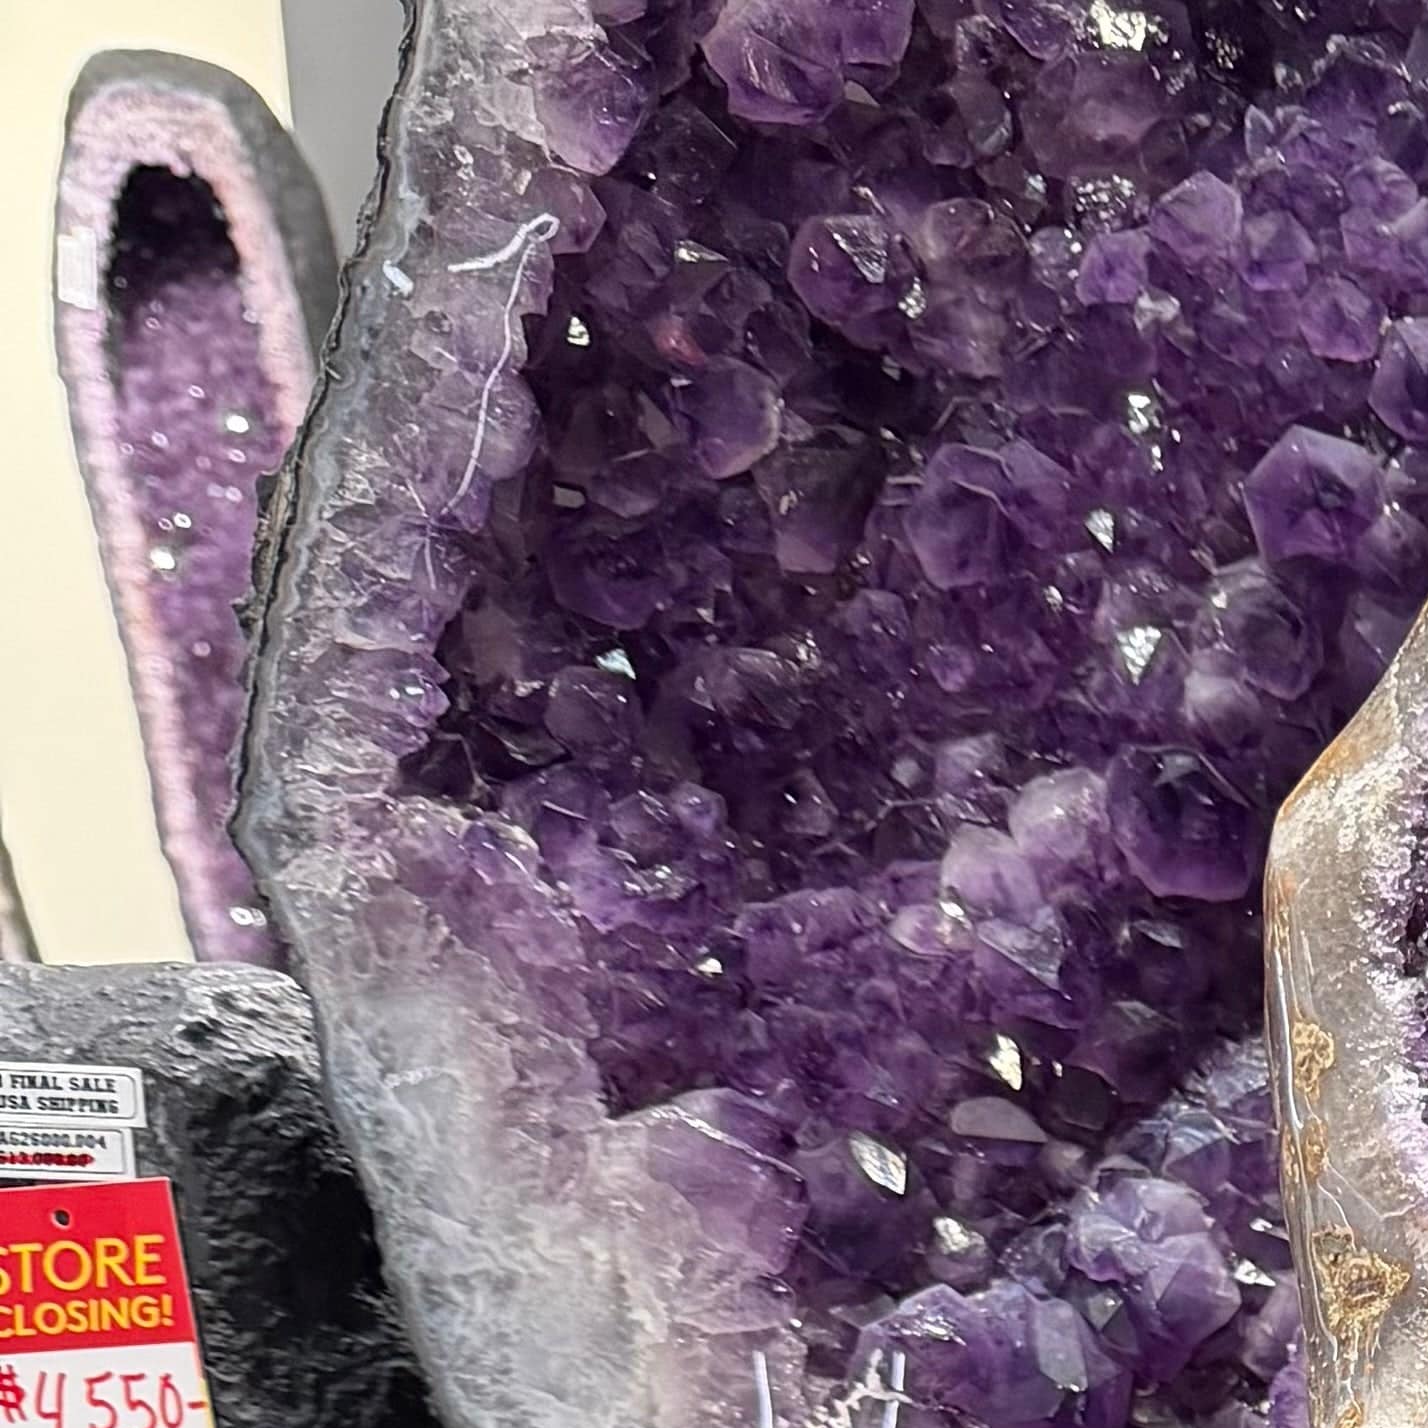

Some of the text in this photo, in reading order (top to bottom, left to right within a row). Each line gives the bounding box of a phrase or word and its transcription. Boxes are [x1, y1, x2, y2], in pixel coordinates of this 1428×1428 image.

[9, 1073, 63, 1091] FINAL
[68, 1076, 117, 1093] SALE
[37, 1095, 119, 1114] SHIPPING
